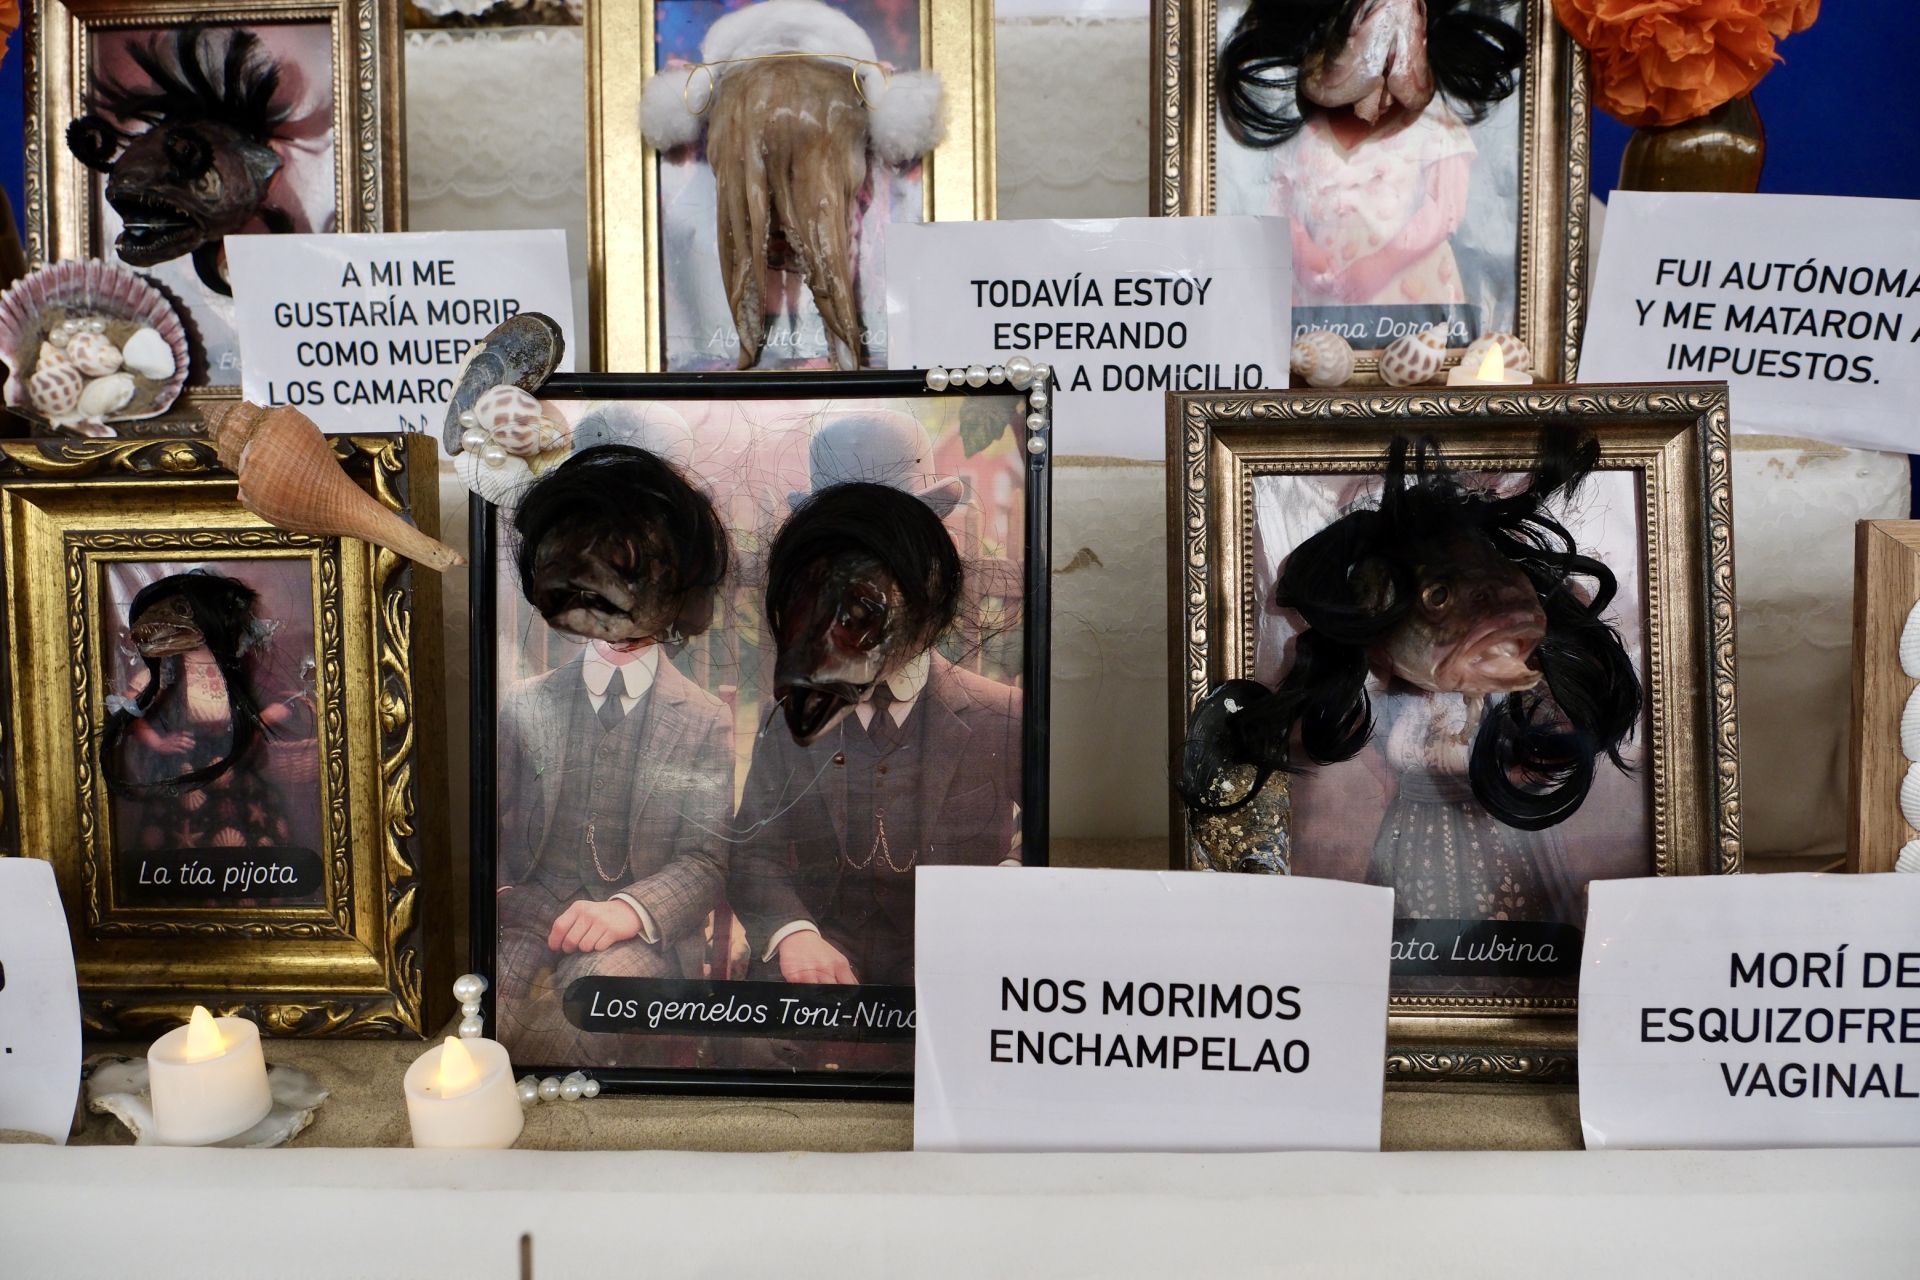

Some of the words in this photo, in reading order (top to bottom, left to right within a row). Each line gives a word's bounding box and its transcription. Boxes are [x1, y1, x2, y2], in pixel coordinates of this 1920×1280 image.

[342, 261, 361, 287] A
[370, 260, 402, 286] MI
[413, 260, 456, 286] ME
[970, 272, 1104, 307] TODAVÍA
[1114, 277, 1213, 306] ESTOY
[1655, 258, 1712, 288] FUI
[274, 295, 418, 328] GUSTARÍA
[428, 298, 520, 325] MORIR
[1635, 299, 1656, 326] Y
[1663, 301, 1716, 330] ME
[1724, 304, 1903, 342] MATARON
[994, 321, 1188, 349] ESPERANDO
[297, 340, 379, 366] COMO
[389, 339, 486, 365] MUER
[1667, 343, 1880, 385] IMPUESTOS.
[268, 380, 325, 406] LOS
[1071, 364, 1093, 391] A
[1103, 363, 1269, 391] DOMICILIO.
[139, 860, 171, 885] La
[180, 860, 216, 885] tía
[223, 861, 298, 892] pijota
[1450, 934, 1559, 962] Lubina
[1730, 943, 1850, 988] MORÍ
[1862, 952, 1920, 988] DE
[590, 991, 638, 1019] Los
[647, 994, 768, 1028] gemelos
[1001, 976, 1087, 1015] NOS
[1102, 980, 1301, 1020] MORIMOS
[1641, 1007, 1920, 1043] ESQUIZOFRE
[990, 1028, 1310, 1074] ENCHAMPELAO
[1719, 1062, 1920, 1098] VAGINAL
